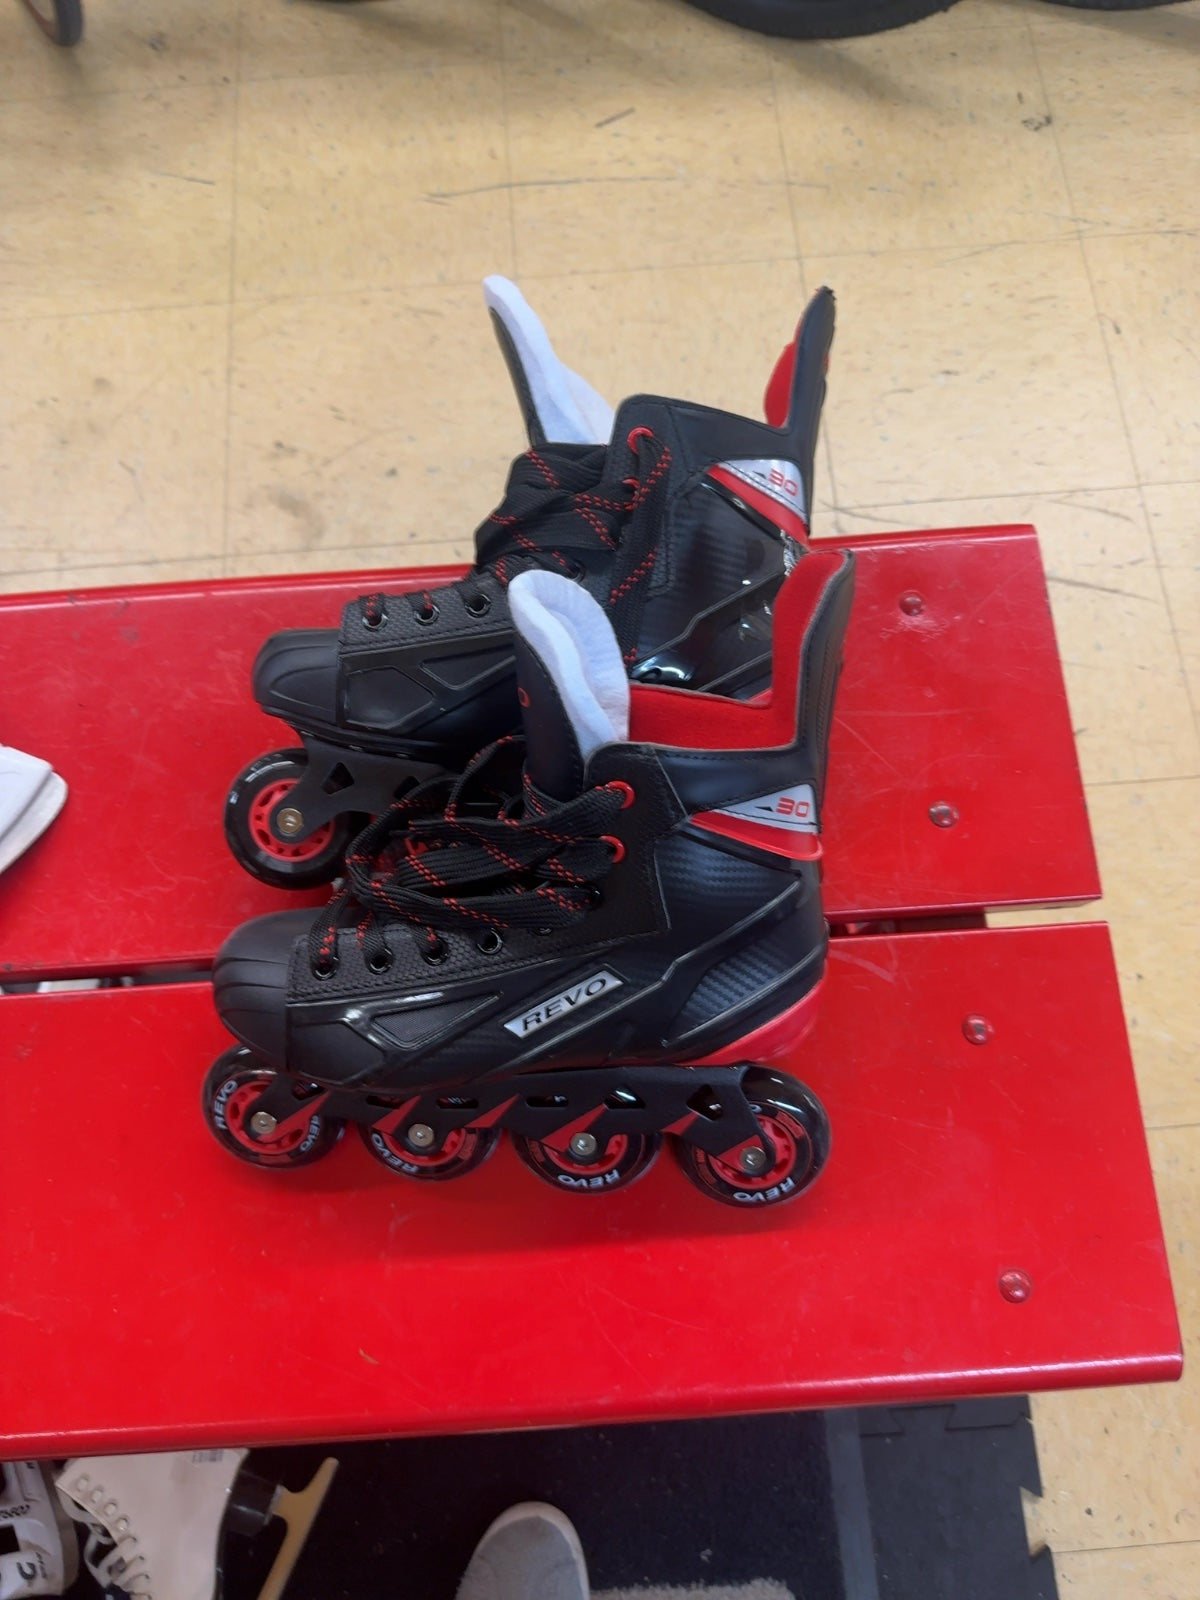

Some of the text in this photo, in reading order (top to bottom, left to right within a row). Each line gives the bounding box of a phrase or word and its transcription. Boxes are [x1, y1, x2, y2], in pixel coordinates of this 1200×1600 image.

[769, 468, 799, 497] 30
[776, 797, 810, 818] 30
[523, 978, 607, 1031] REVO
[214, 1080, 238, 1129] REVO
[371, 1133, 419, 1173] REVO
[557, 1169, 621, 1188] REVO
[733, 1176, 796, 1202] REVO
